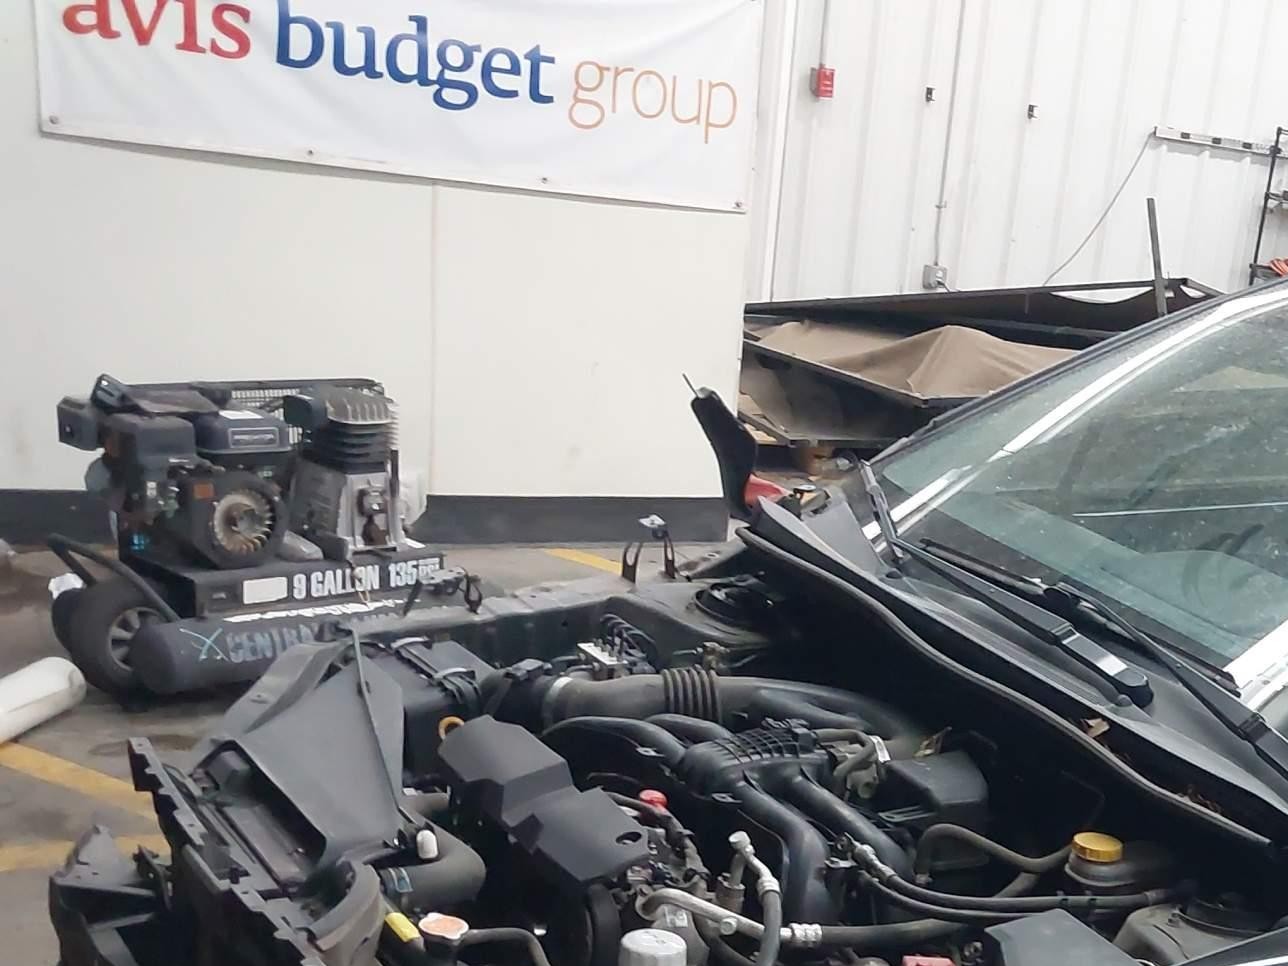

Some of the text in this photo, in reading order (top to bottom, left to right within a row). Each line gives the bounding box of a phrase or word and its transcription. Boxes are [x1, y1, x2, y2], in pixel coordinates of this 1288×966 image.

[62, 0, 738, 144] avis budget group
[293, 573, 307, 599] 9
[388, 560, 417, 587] 135
